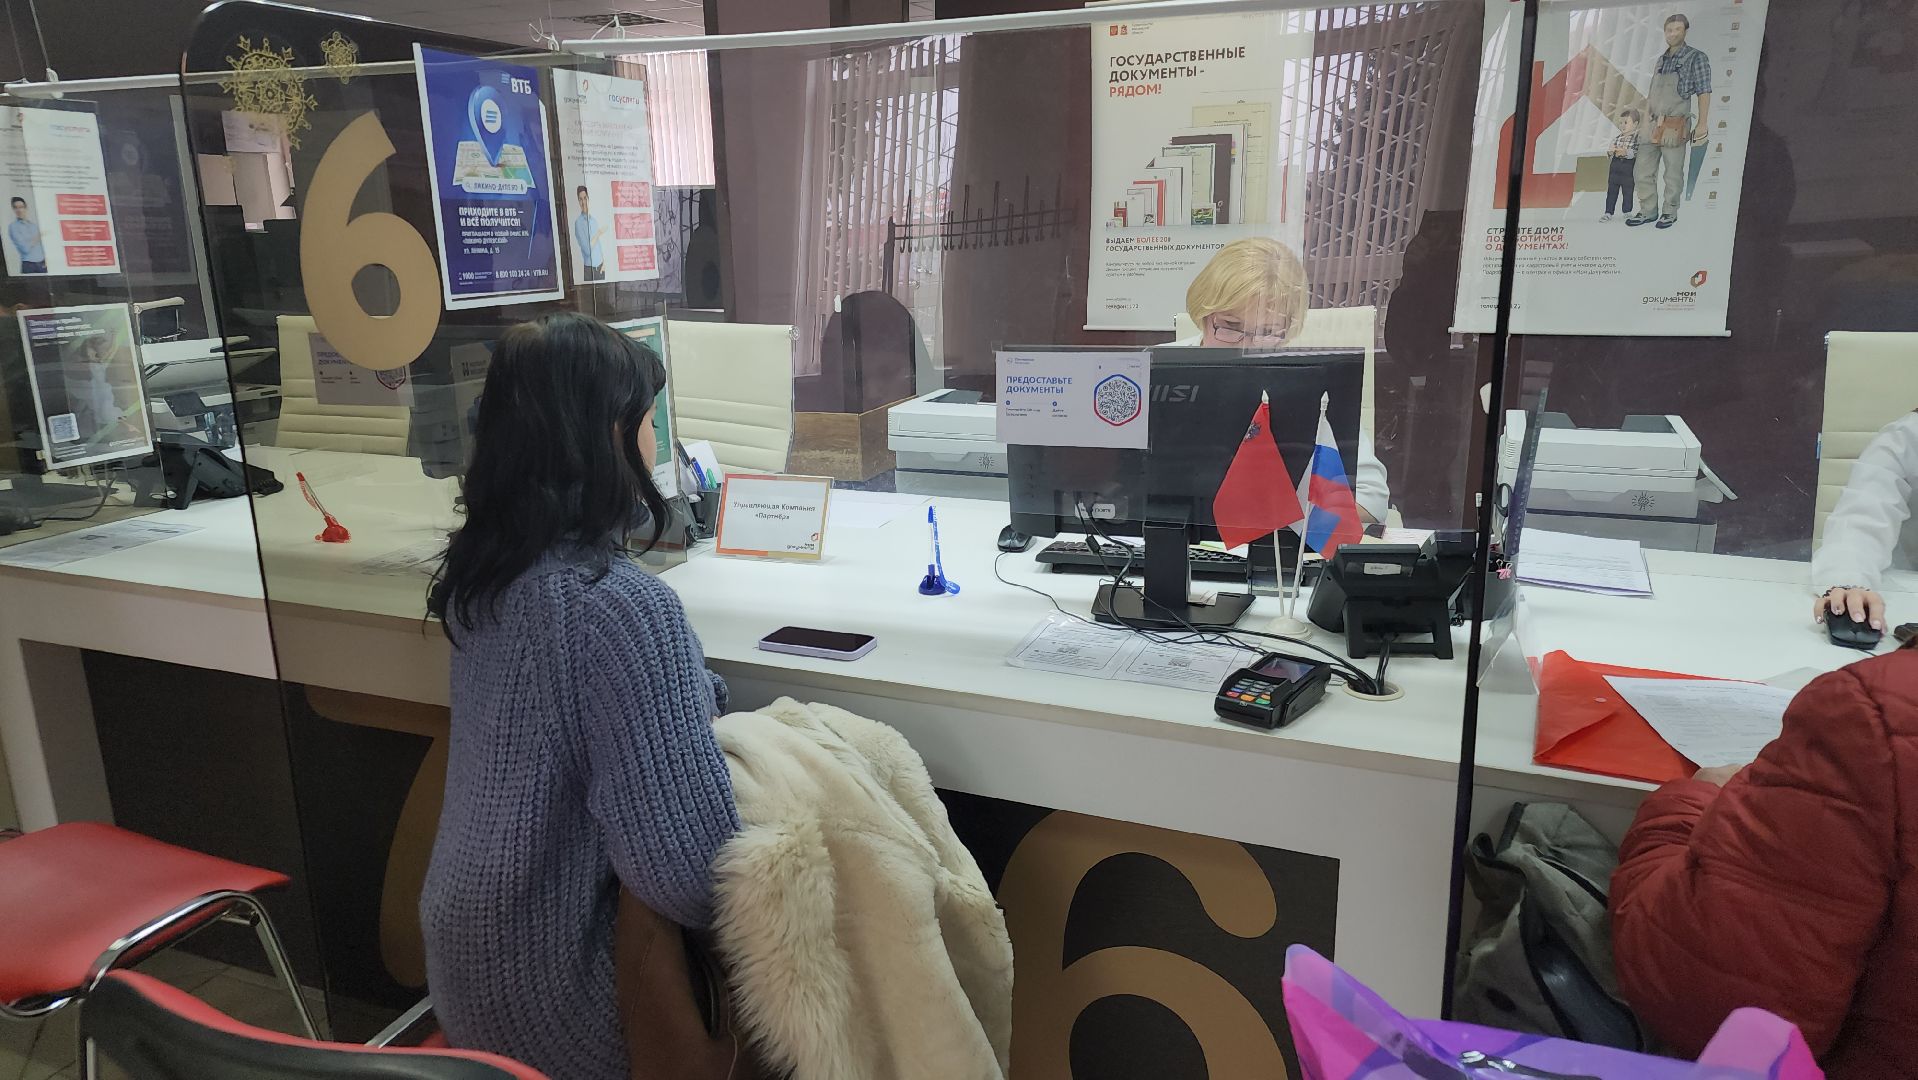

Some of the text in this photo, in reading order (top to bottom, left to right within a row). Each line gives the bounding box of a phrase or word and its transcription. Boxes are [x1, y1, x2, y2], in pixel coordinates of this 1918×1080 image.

[1110, 46, 1245, 67] ГОСУДАРСТВЕННЫЕ
[1109, 66, 1197, 84] ДОКУМЕНТЫ
[510, 78, 532, 95] ВТБ
[1109, 83, 1162, 98] РЯДОМ!
[458, 206, 499, 217] ПРИХОДИТЕ
[499, 208, 504, 216] В
[504, 207, 517, 216] ВТБ
[460, 218, 466, 227] И
[480, 217, 521, 227] ПОЛУЧИТСЯ!
[1486, 226, 1565, 235] СТРТЕ ДОМ?
[300, 111, 441, 371] 6
[1136, 236, 1159, 244] БОЛЕЕ
[1486, 234, 1563, 242] ПОЗОТИМСЯ
[1105, 244, 1174, 252] ГОСУДАРСТВЕННЫХ
[1495, 243, 1569, 251] ДУМЕНТАХ!
[1006, 375, 1073, 385] ПРЕДОСТАВЬТЕ
[1005, 386, 1064, 395] ДОКУМЕНТЫ
[781, 503, 816, 512] Компания
[996, 809, 1289, 1080] 6
